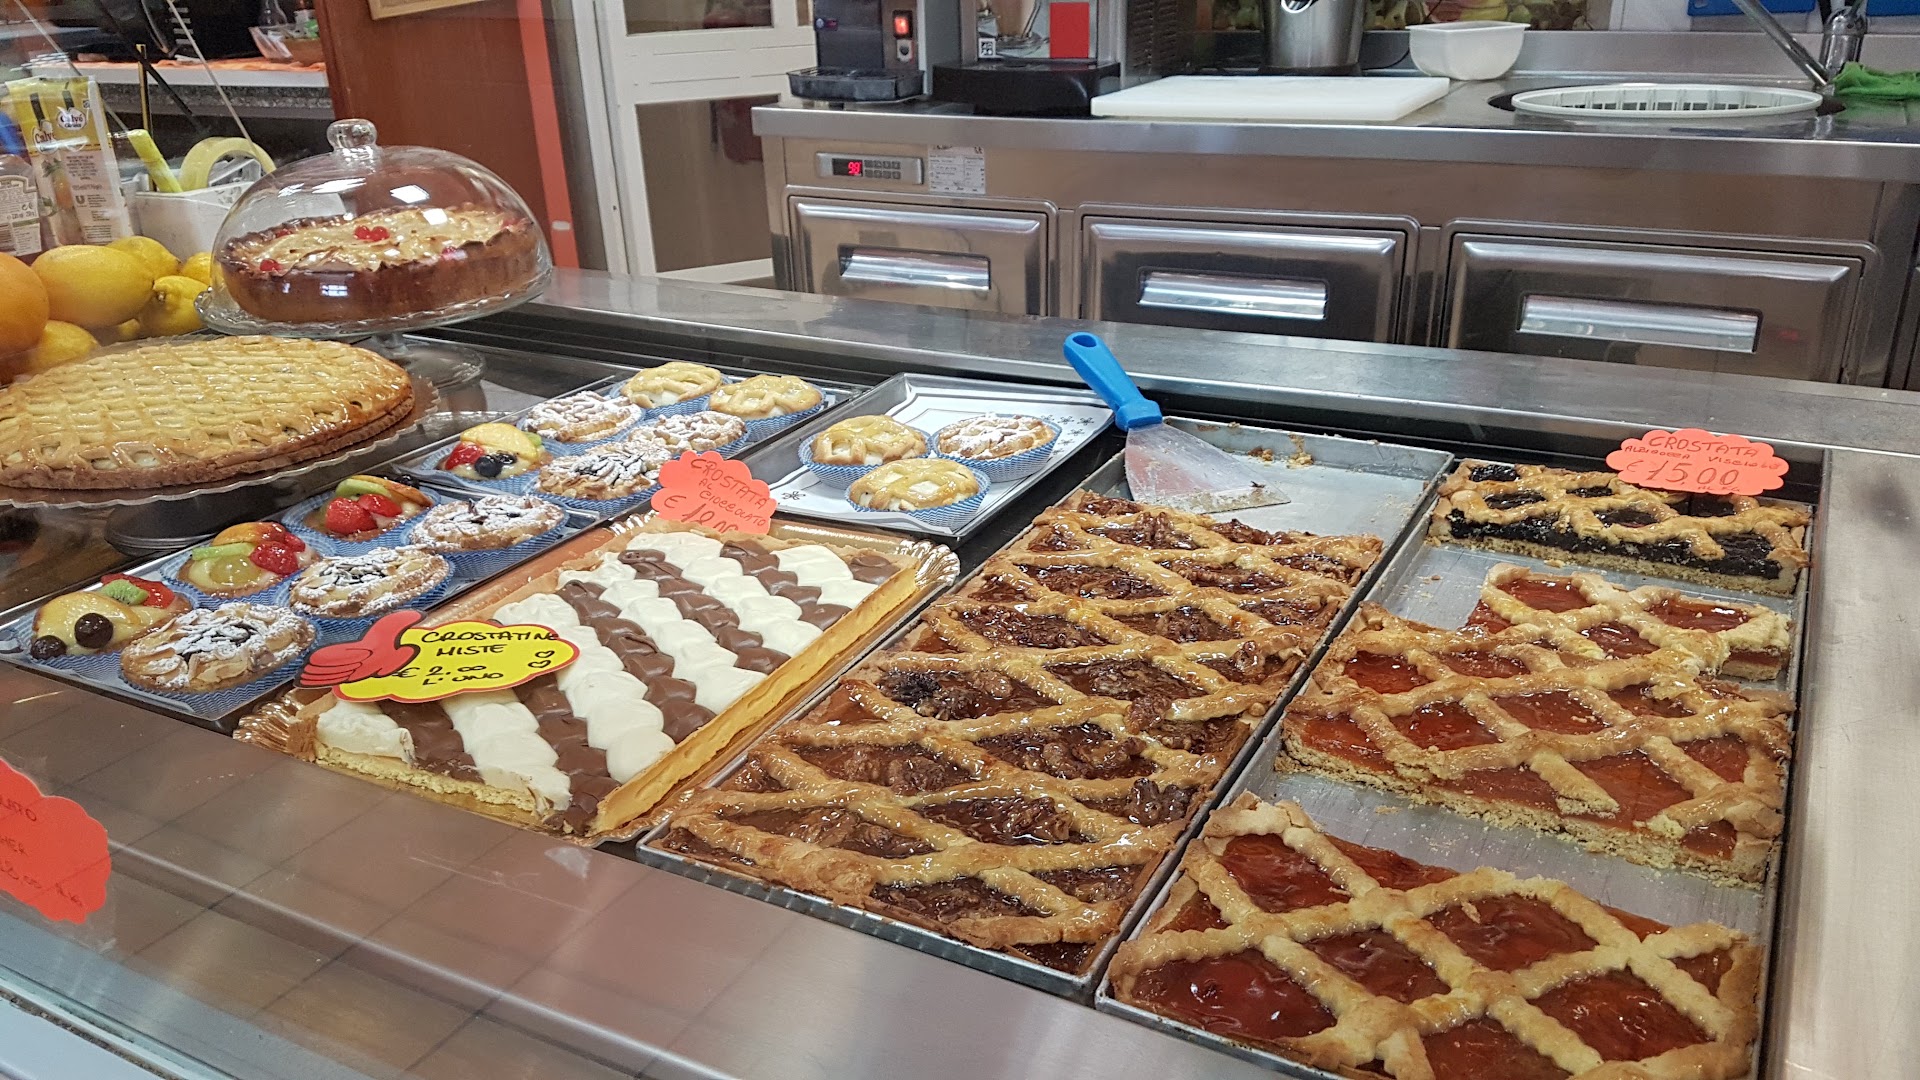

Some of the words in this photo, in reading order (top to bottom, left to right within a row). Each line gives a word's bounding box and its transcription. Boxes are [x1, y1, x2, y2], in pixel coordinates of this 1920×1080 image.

[35, 130, 55, 143] Calv
[1649, 436, 1759, 457] CROSTATA
[691, 458, 767, 509] CROSTATA
[699, 478, 712, 490] AL
[699, 490, 766, 527] CIOCCOLATO
[421, 631, 559, 643] CROSTATINE
[436, 644, 508, 657] MISTE
